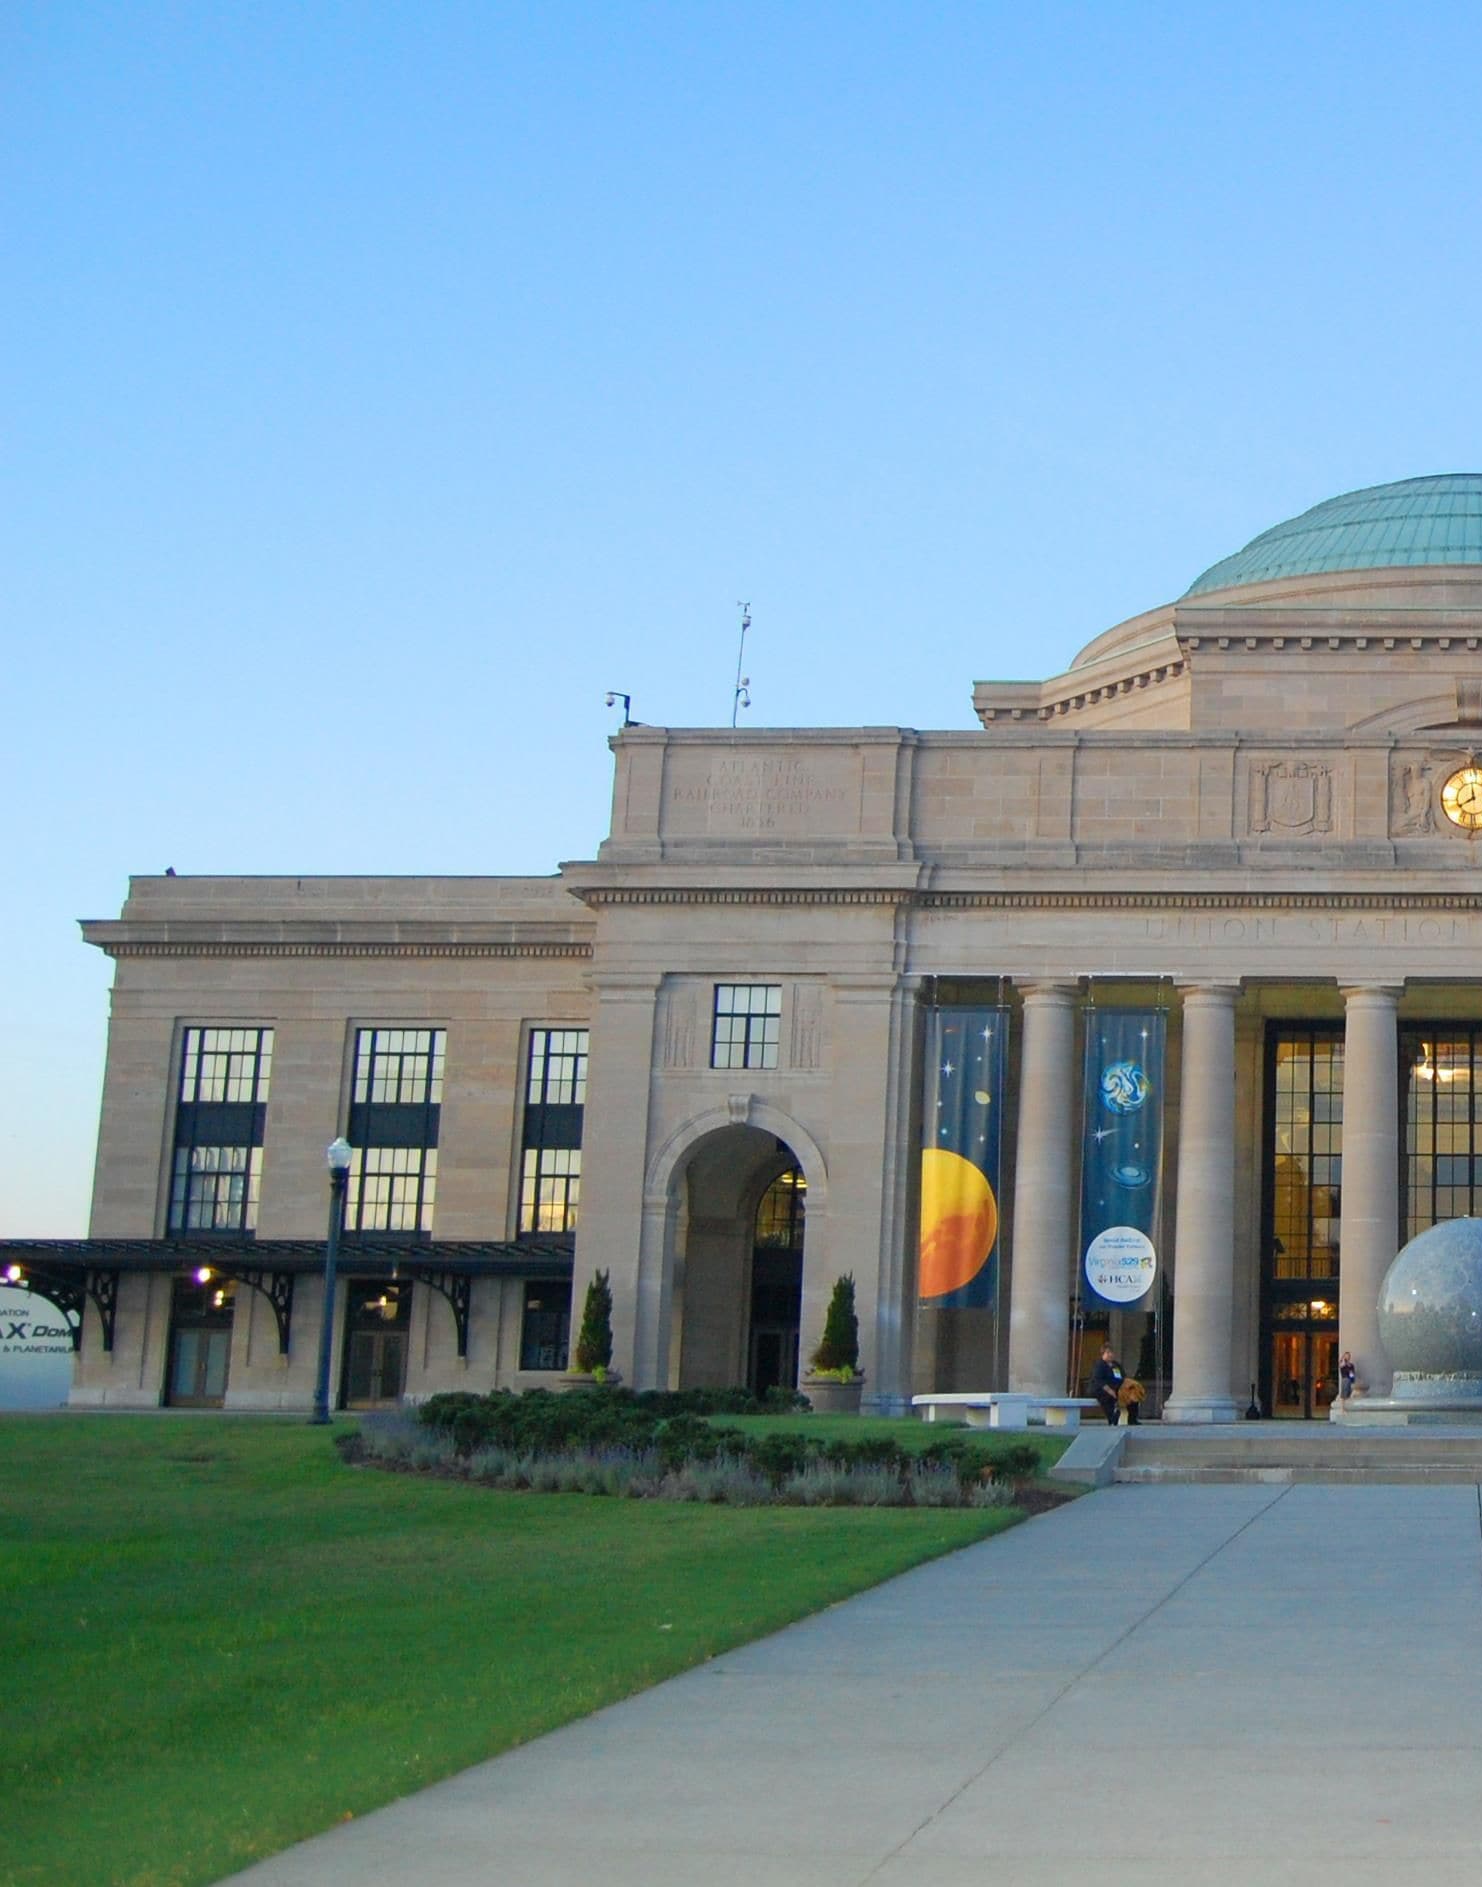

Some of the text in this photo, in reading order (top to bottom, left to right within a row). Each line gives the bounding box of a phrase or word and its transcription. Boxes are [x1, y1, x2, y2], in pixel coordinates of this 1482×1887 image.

[720, 760, 803, 773] ATLANTIC
[673, 788, 848, 801] RAILROAD COMPANY
[1145, 918, 1278, 940] UNION
[1308, 918, 1472, 941] STATION
